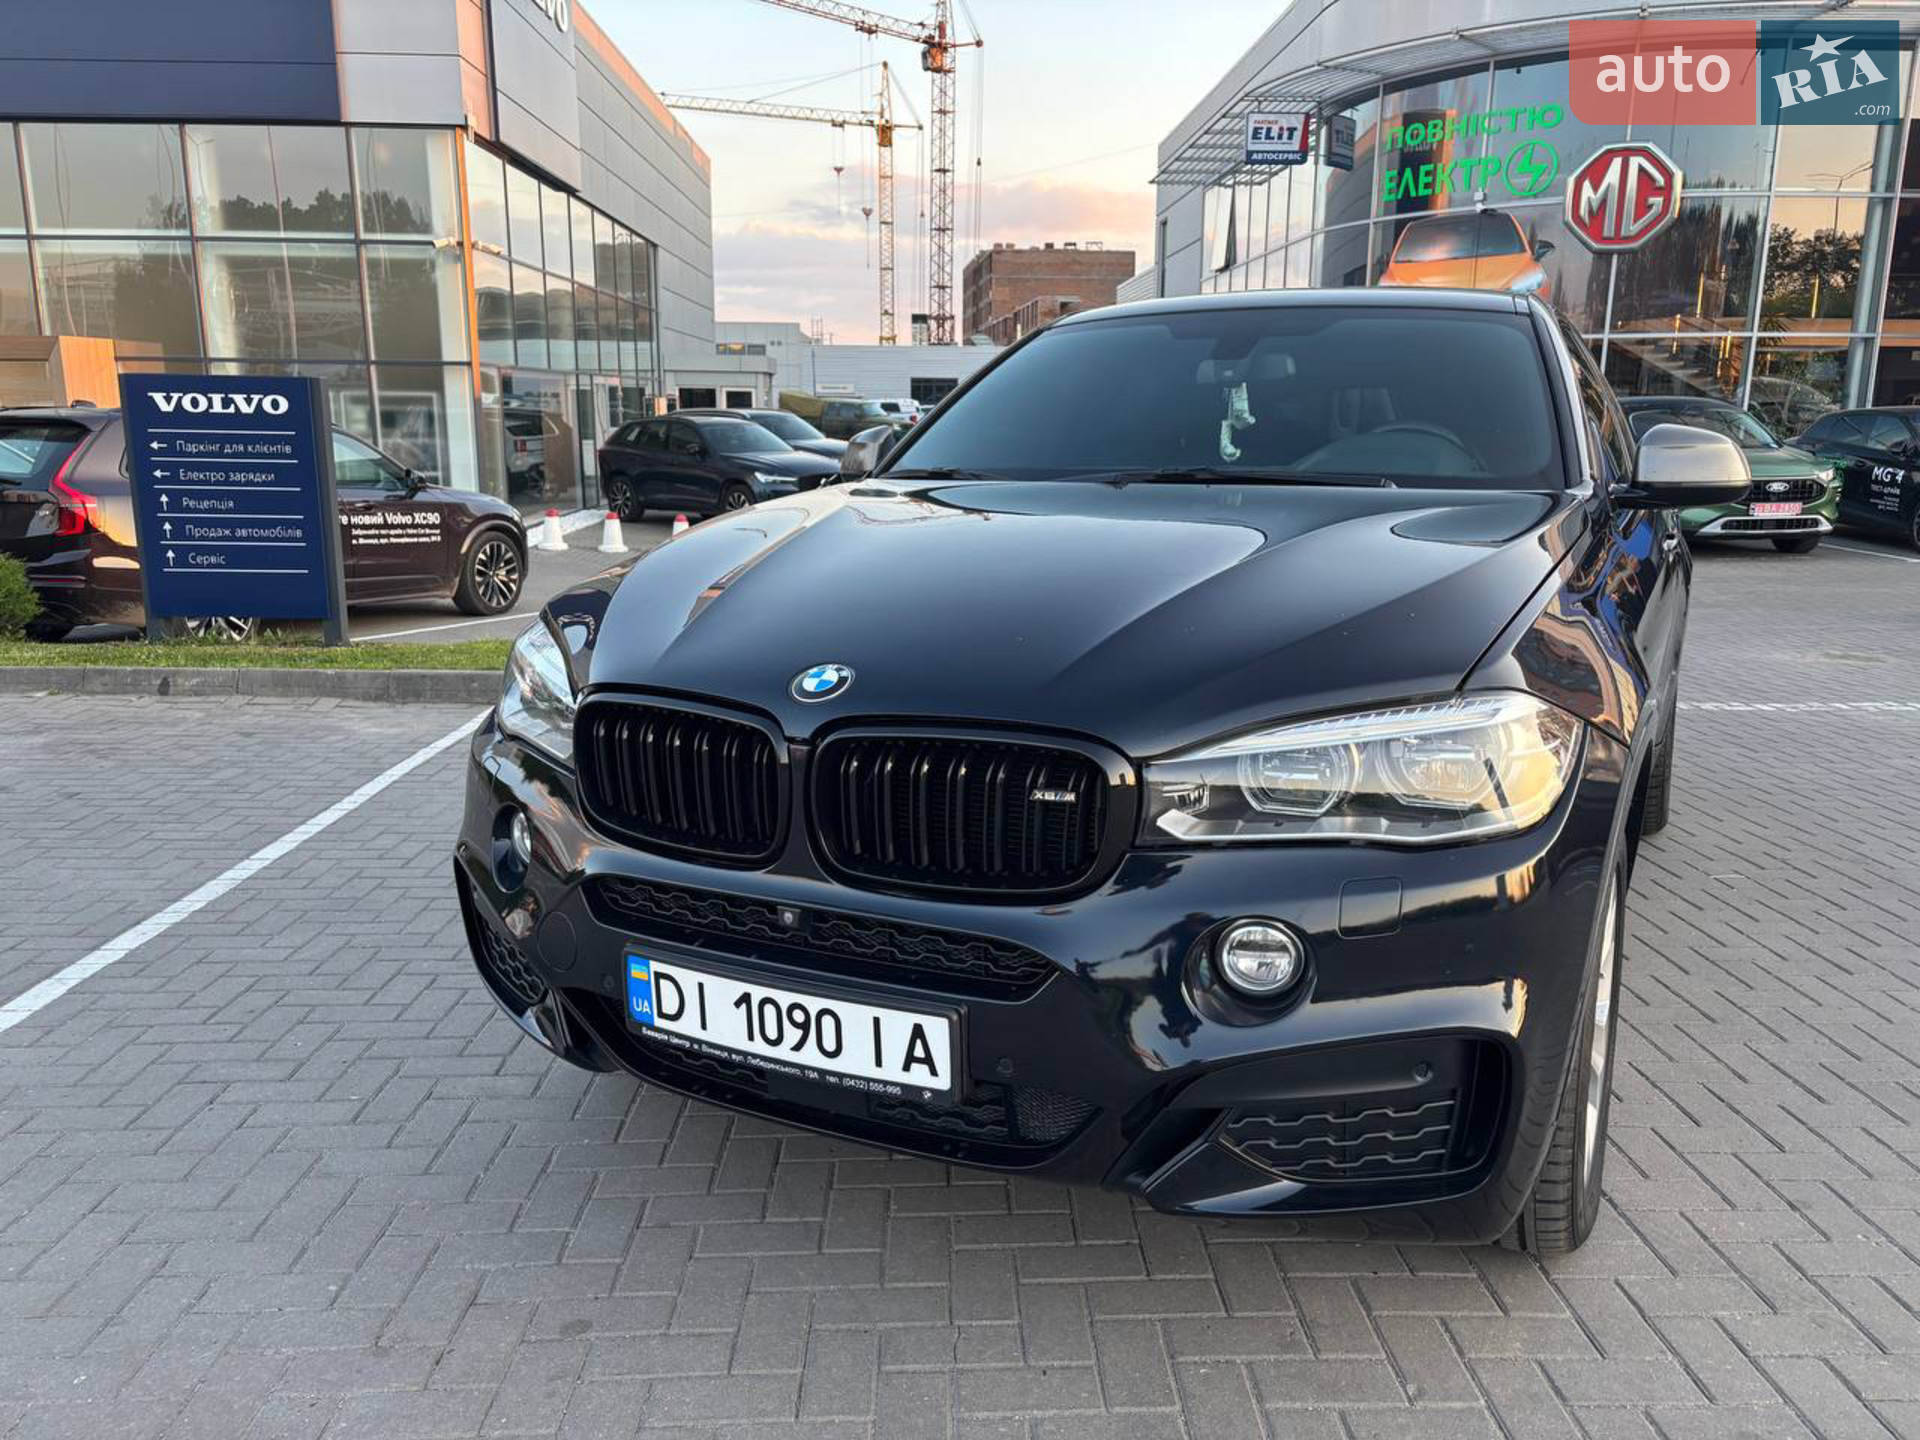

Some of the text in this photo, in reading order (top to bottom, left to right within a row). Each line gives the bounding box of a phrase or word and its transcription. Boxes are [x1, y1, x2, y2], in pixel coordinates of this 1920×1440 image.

[1386, 104, 1564, 151] ПОВНІСТЮ
[1579, 156, 1665, 238] MG
[147, 392, 289, 415] VOLVO
[176, 440, 292, 454] Паркінг для клієнтів
[179, 469, 275, 483] Електро зарядки
[182, 497, 235, 510] Рецепція
[350, 512, 384, 524] новий
[385, 512, 412, 524] Volvo
[413, 512, 440, 524] XC90
[185, 525, 303, 538] Продаж автомобілів
[188, 552, 226, 566] Сервіс
[633, 997, 651, 1014] UA
[653, 970, 939, 1077] DI 1090 IA
